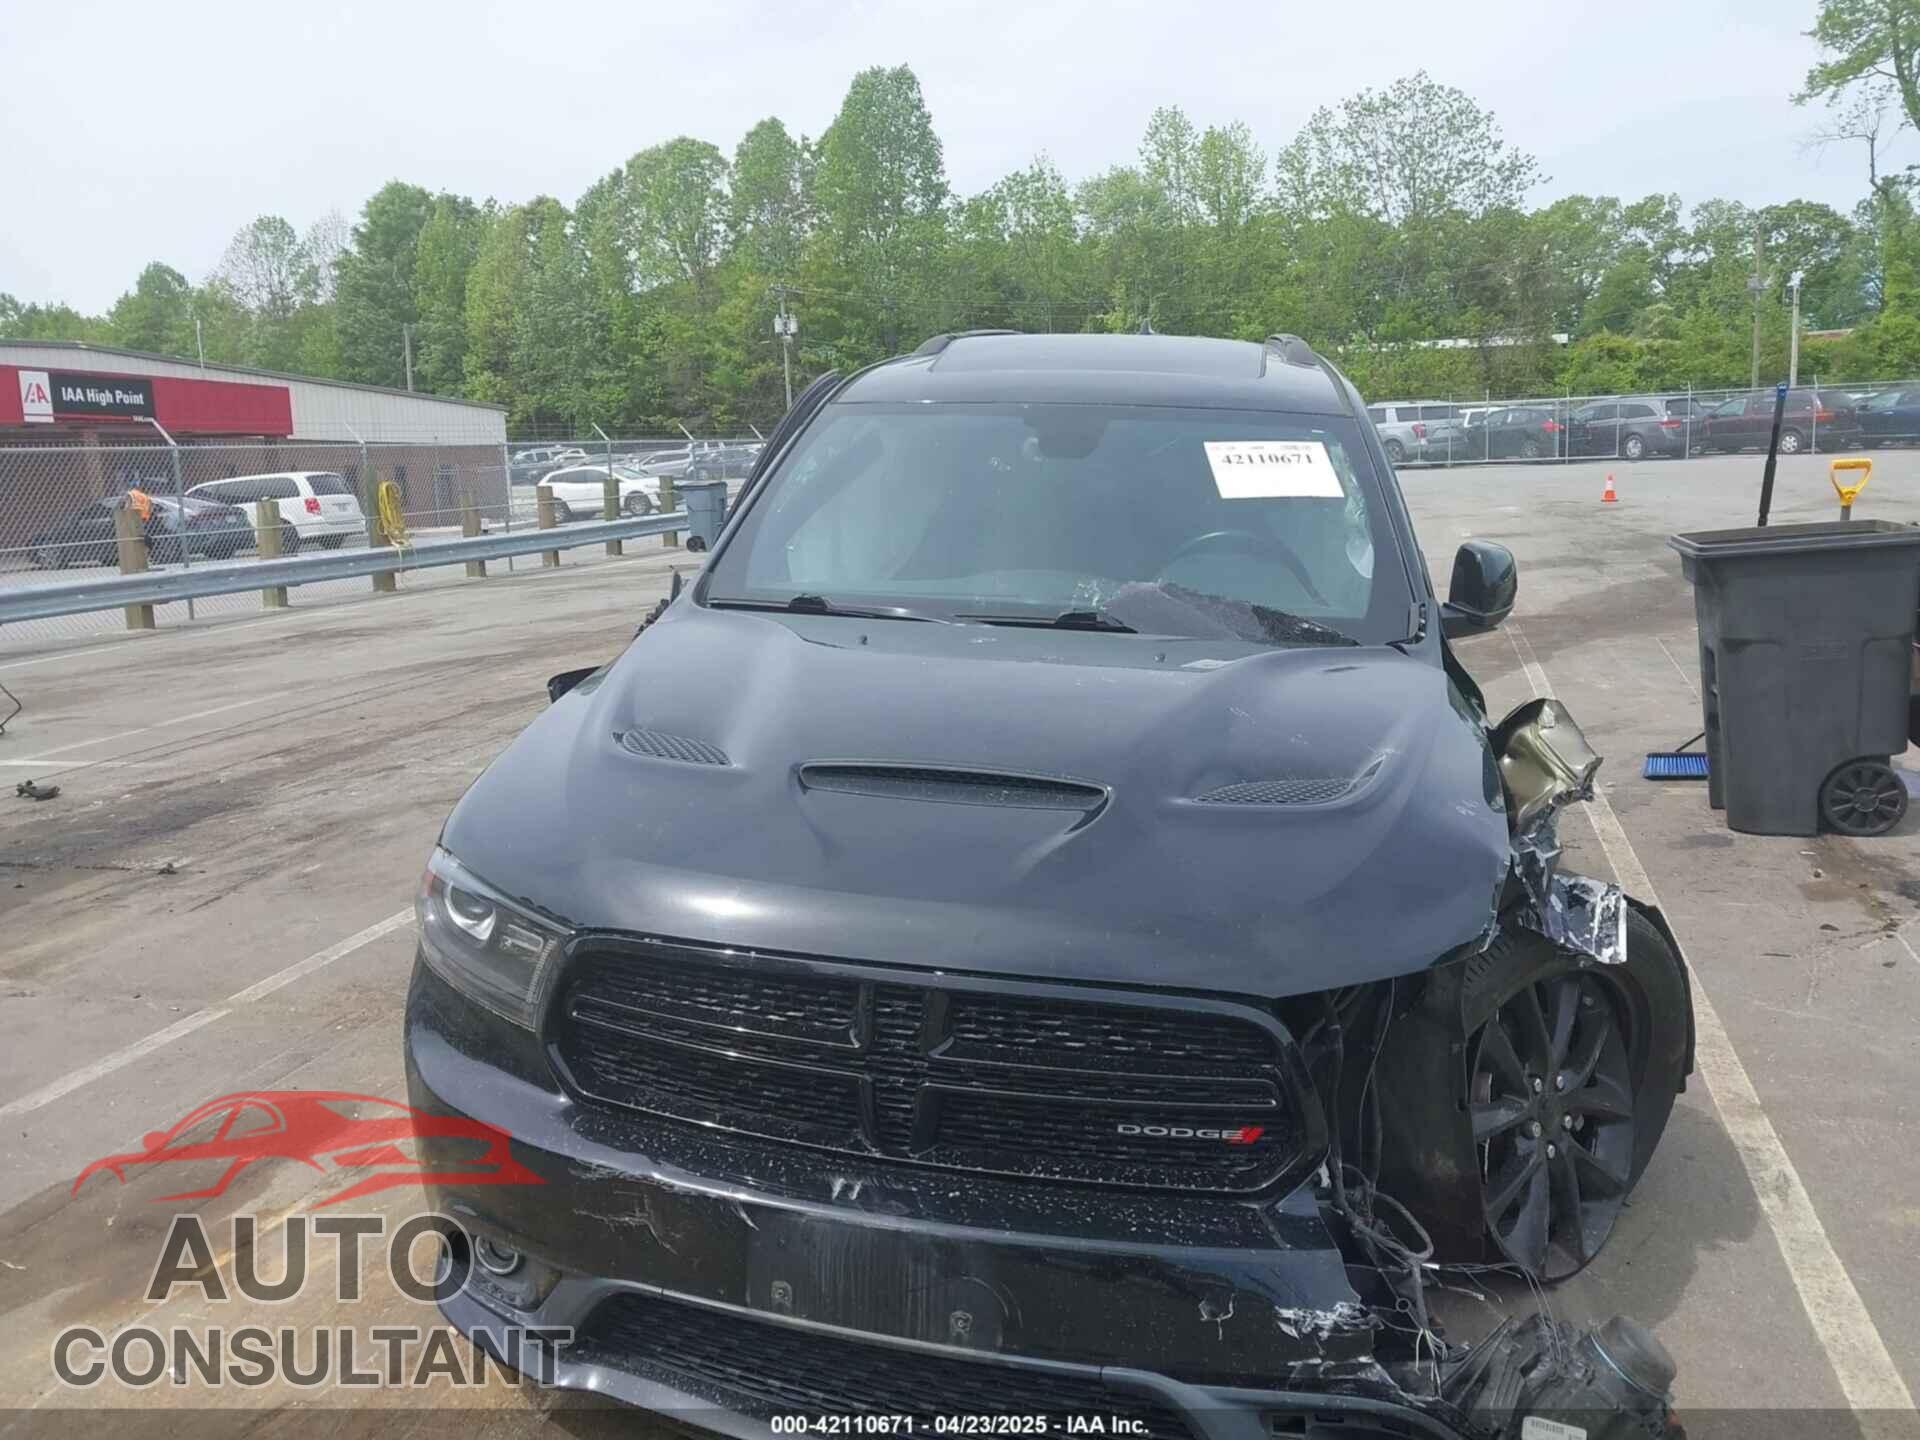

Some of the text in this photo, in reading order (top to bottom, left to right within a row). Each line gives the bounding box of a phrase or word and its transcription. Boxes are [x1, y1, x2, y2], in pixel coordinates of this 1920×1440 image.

[61, 386, 145, 407] IAA High Point
[1222, 453, 1313, 465] 42110671
[1117, 1124, 1244, 1140] DODGE
